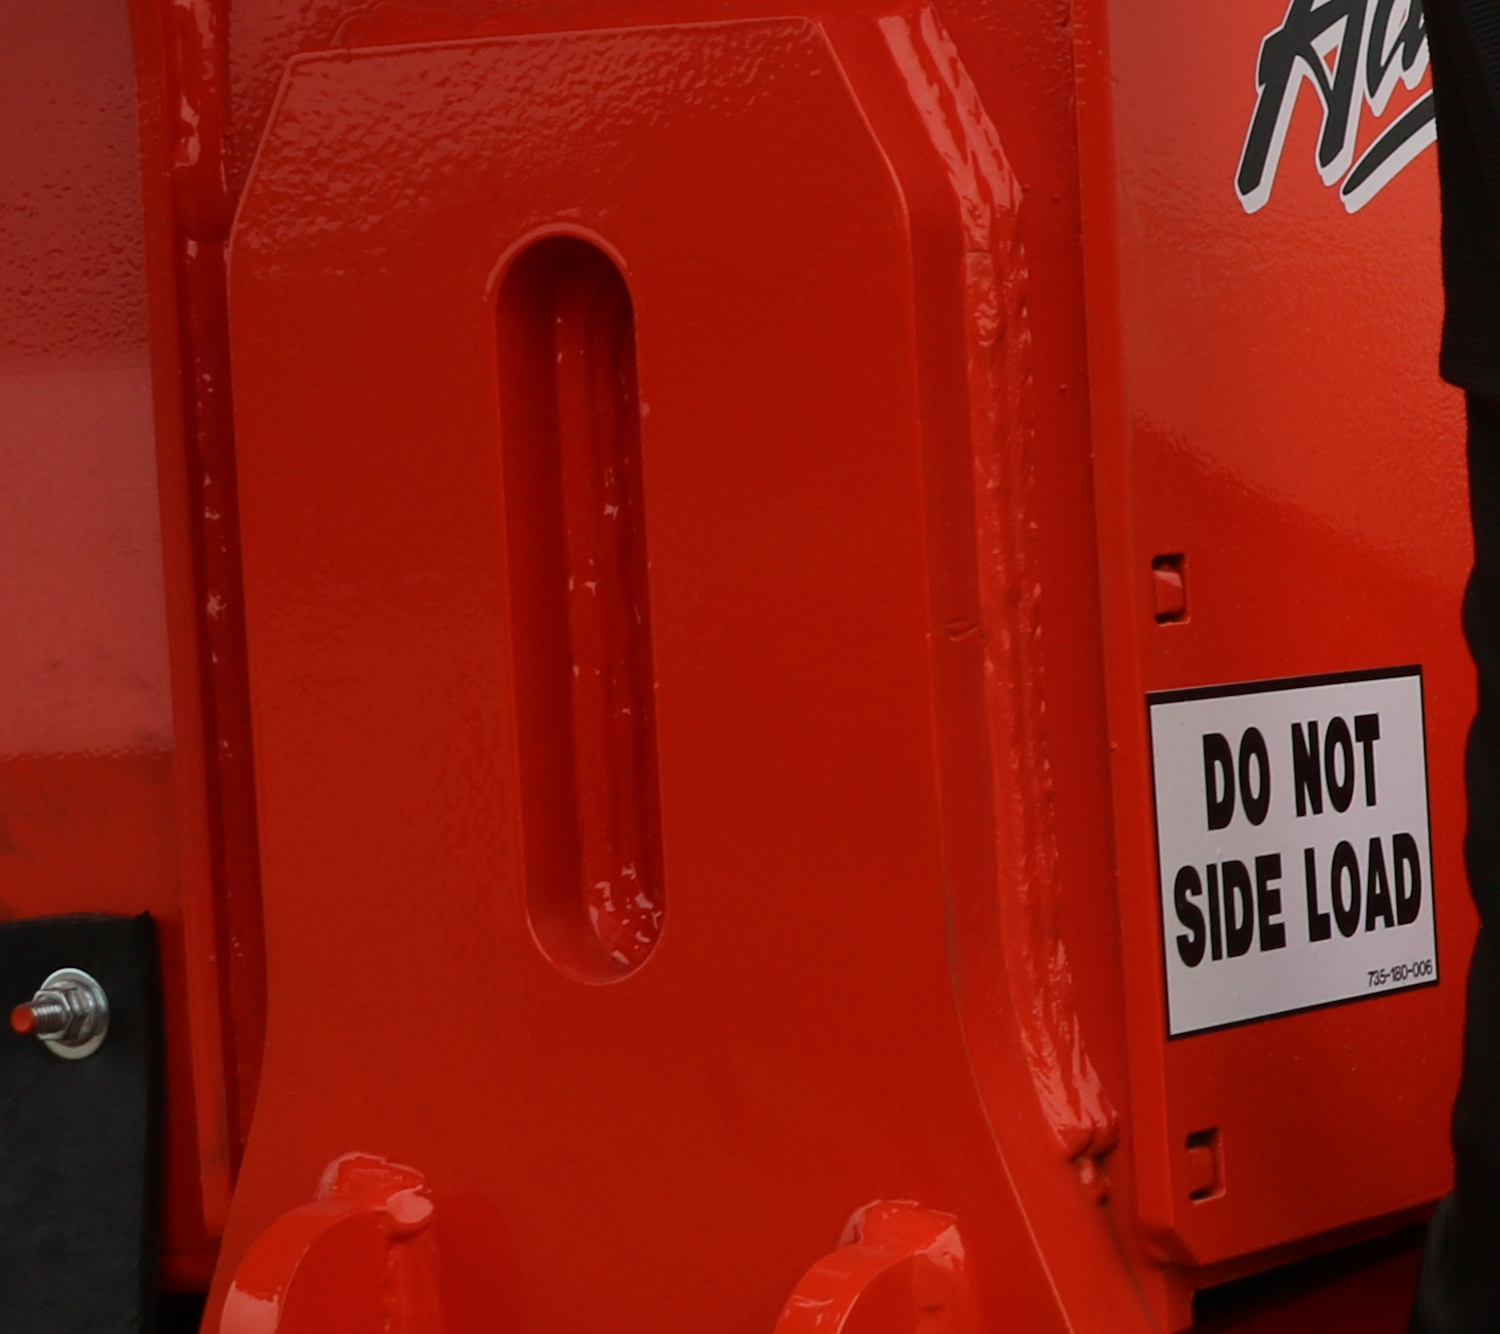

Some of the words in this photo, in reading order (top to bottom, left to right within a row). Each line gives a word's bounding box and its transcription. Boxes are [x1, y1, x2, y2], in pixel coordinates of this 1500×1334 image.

[1202, 726, 1271, 831] DO
[1291, 712, 1380, 818] NOT
[1173, 853, 1286, 968] SIDE
[1304, 832, 1422, 943] LOAD
[1367, 959, 1433, 988] 735-180-006
